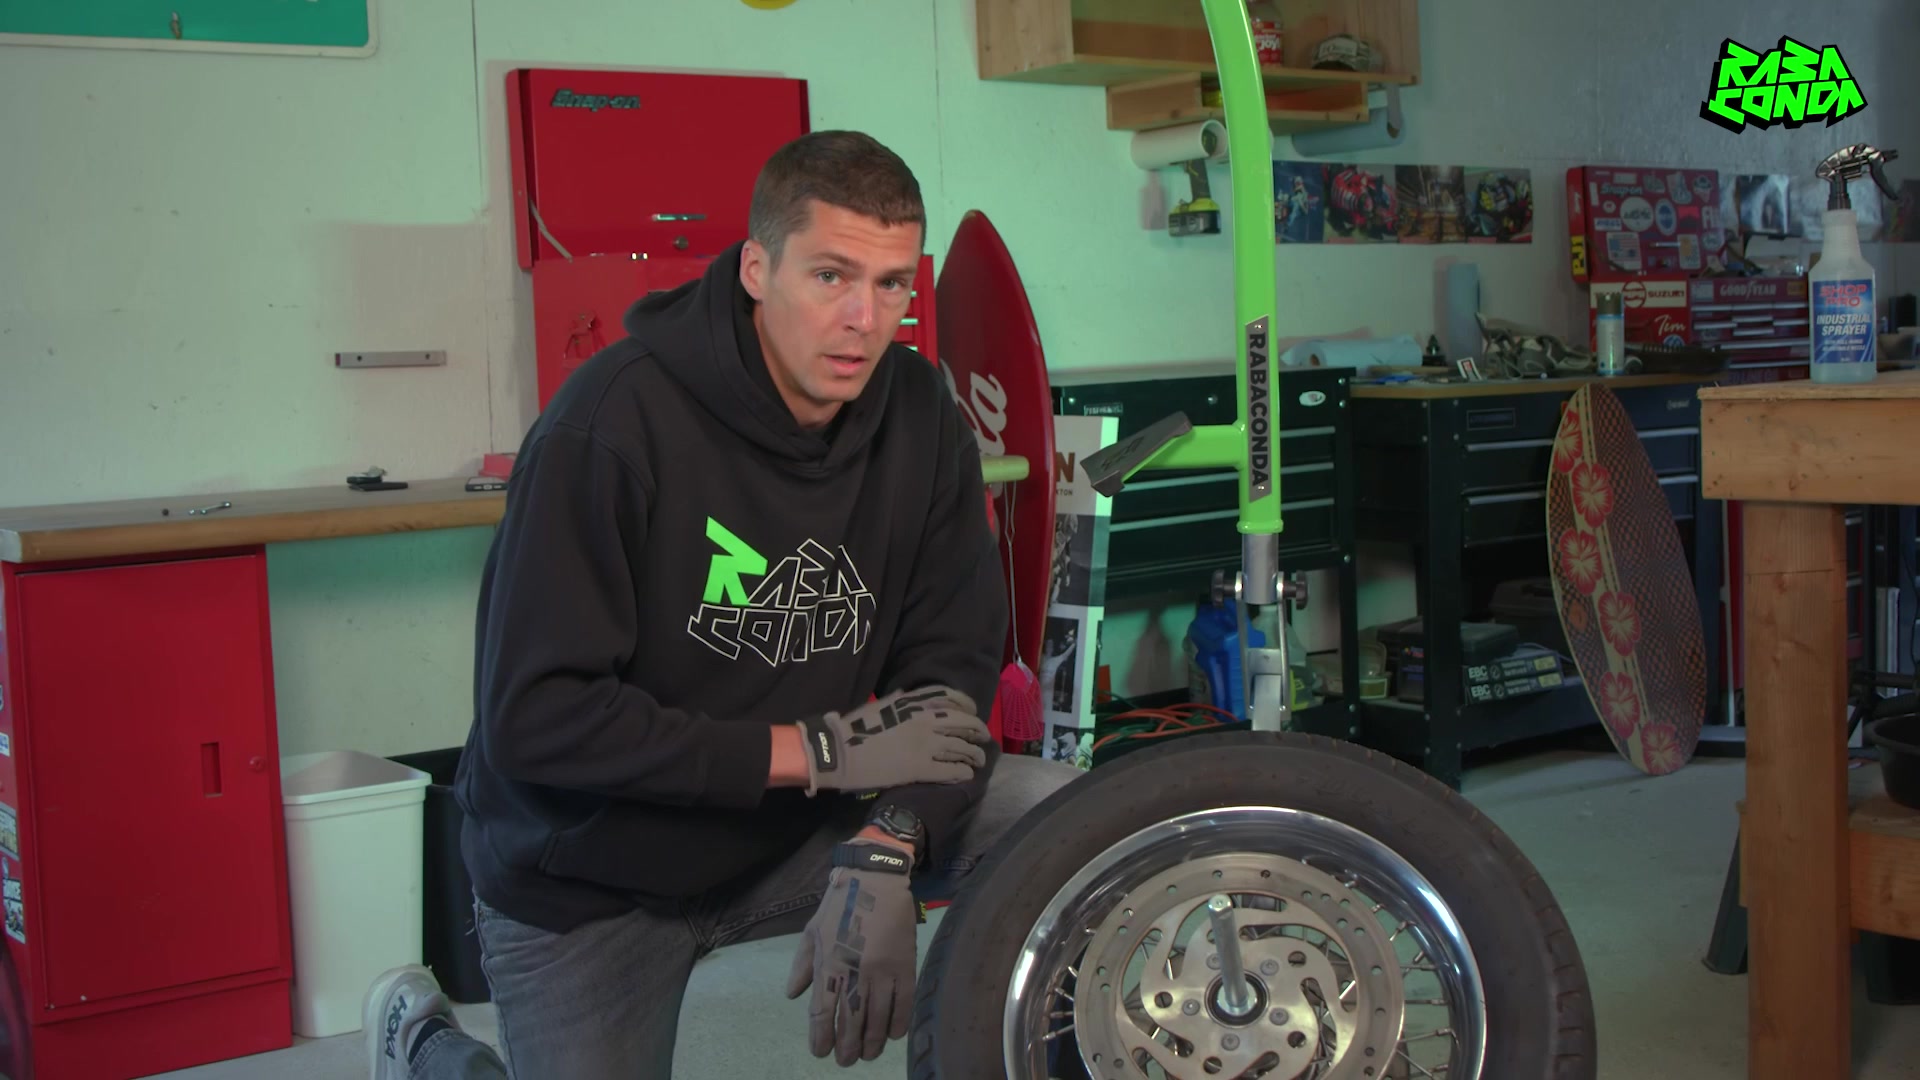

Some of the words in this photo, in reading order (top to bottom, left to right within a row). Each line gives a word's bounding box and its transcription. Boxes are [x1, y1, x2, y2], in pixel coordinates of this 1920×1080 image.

[1647, 290, 1685, 299] SUZUKI
[1820, 284, 1868, 297] SHOP
[1816, 313, 1871, 325] INDUSTRIAL
[1821, 324, 1868, 336] SPRAYER
[1249, 332, 1269, 487] RABACONDA
[1468, 665, 1488, 679] EBC
[1471, 684, 1491, 698] EBC
[817, 731, 831, 763] OPTION
[869, 853, 903, 866] OPTION
